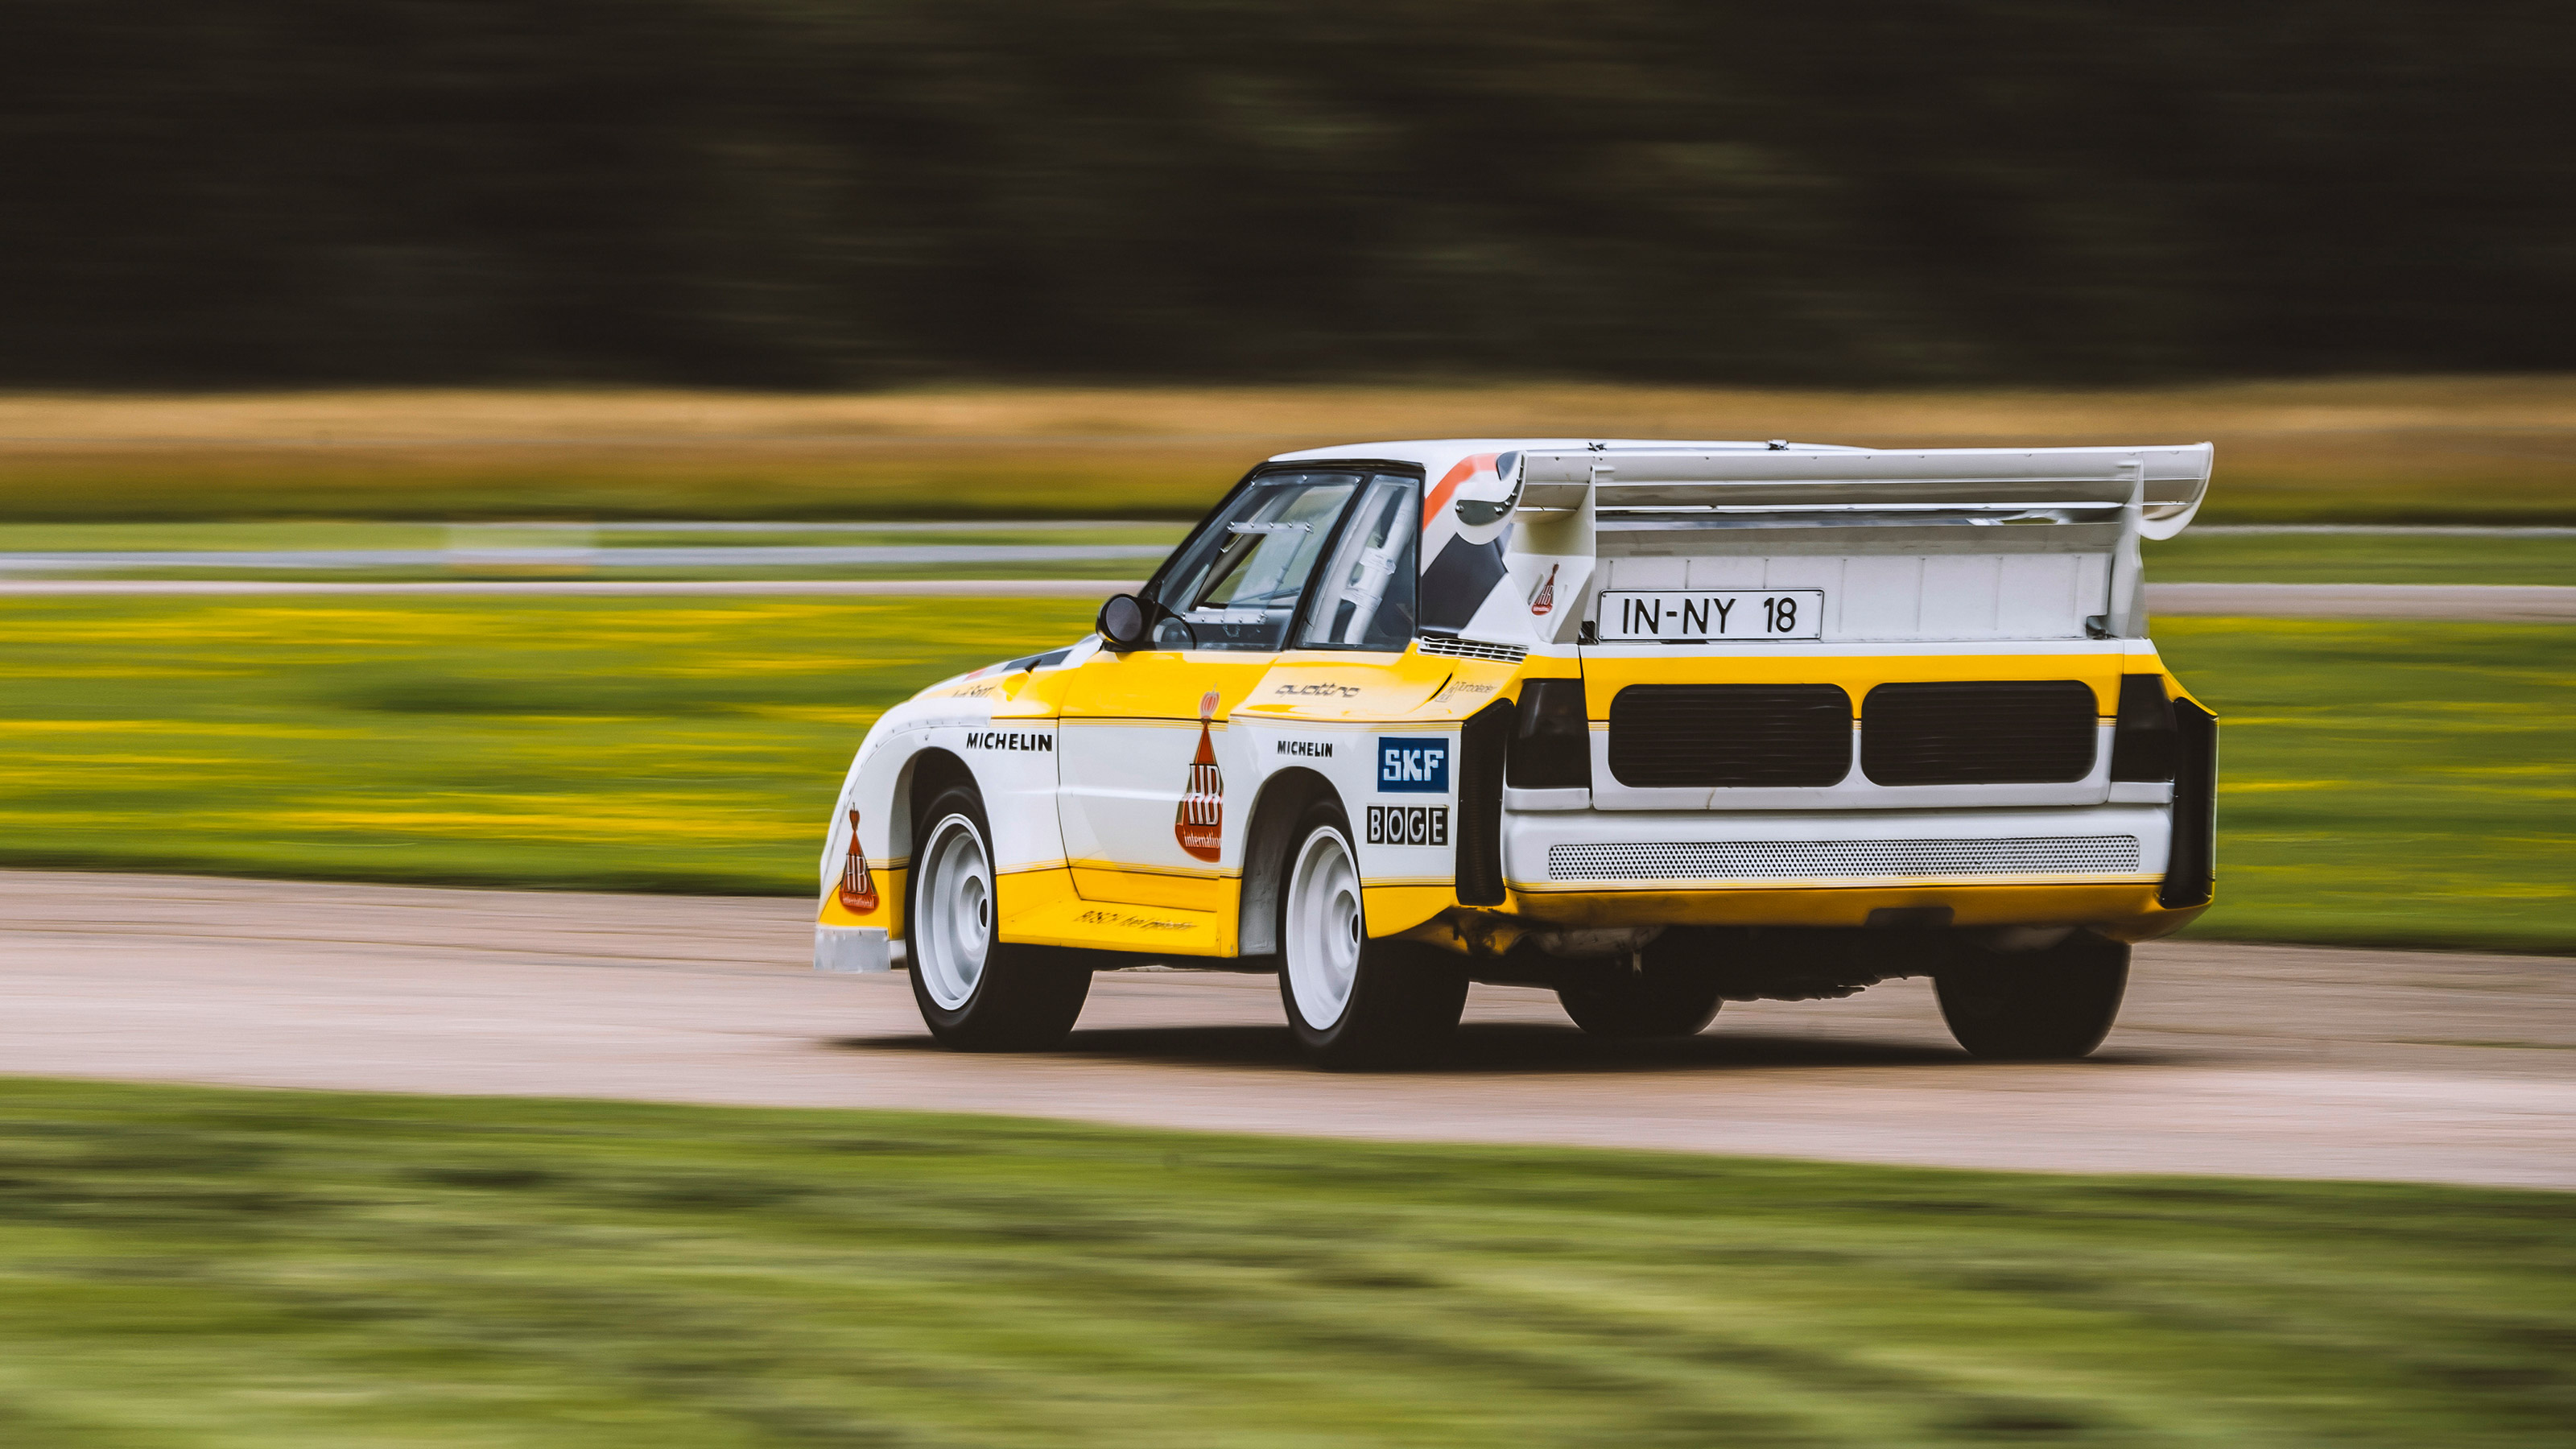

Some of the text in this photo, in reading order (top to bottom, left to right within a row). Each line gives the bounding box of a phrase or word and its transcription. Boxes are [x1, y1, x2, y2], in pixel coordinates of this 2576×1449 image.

[1538, 585, 1554, 605] HB
[1623, 597, 1797, 634] IN-NY 18
[1275, 682, 1361, 699] quattro
[966, 732, 1052, 752] MICHELIN
[1277, 740, 1333, 758] MICHELIN
[1383, 749, 1444, 782] SKF
[1189, 763, 1221, 826] HB
[1370, 808, 1443, 843] BOGE
[846, 853, 868, 895] HB
